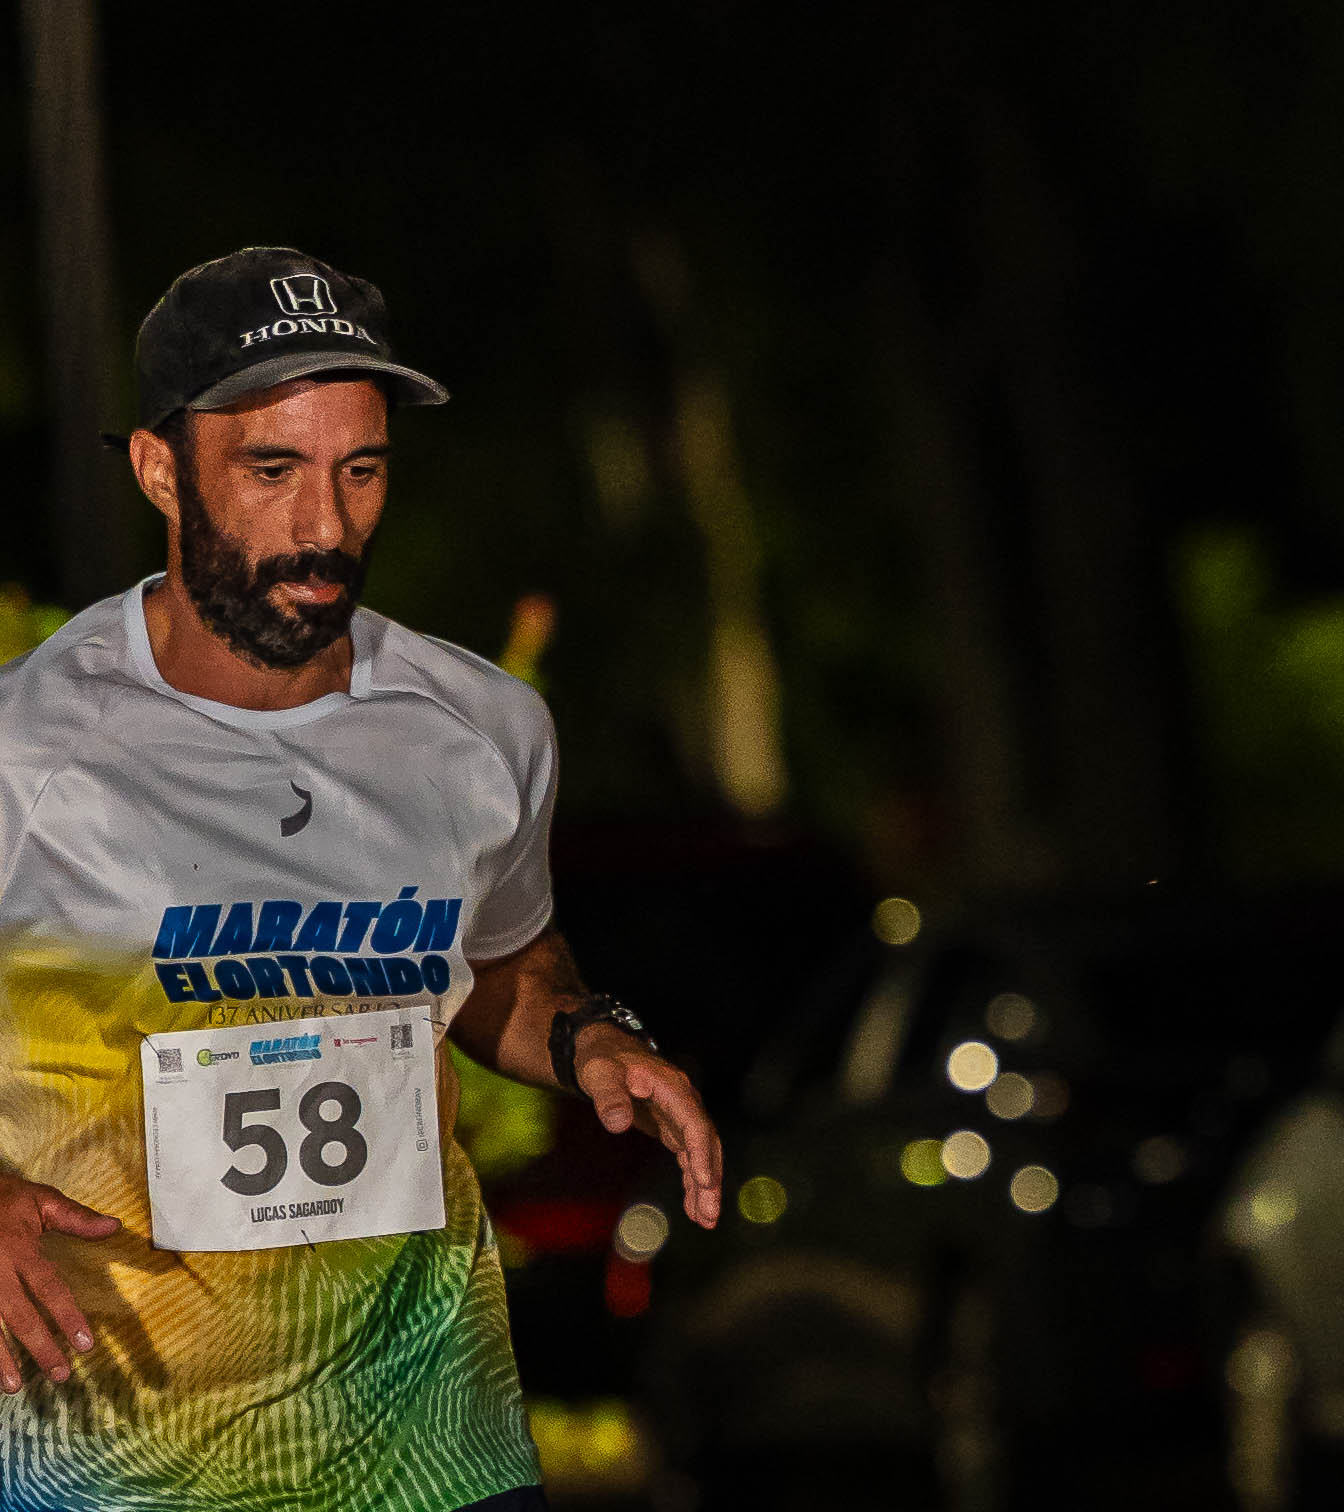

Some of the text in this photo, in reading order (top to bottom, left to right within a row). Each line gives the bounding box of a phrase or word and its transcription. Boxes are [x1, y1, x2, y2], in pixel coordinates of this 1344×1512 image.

[240, 318, 378, 349] HONDA
[151, 885, 463, 959] MARATÓN
[155, 954, 451, 1004] ELORTONDO
[208, 1005, 238, 1025] 137
[220, 1081, 368, 1196] 58
[251, 1198, 345, 1223] LUCAS SAGARDOY
